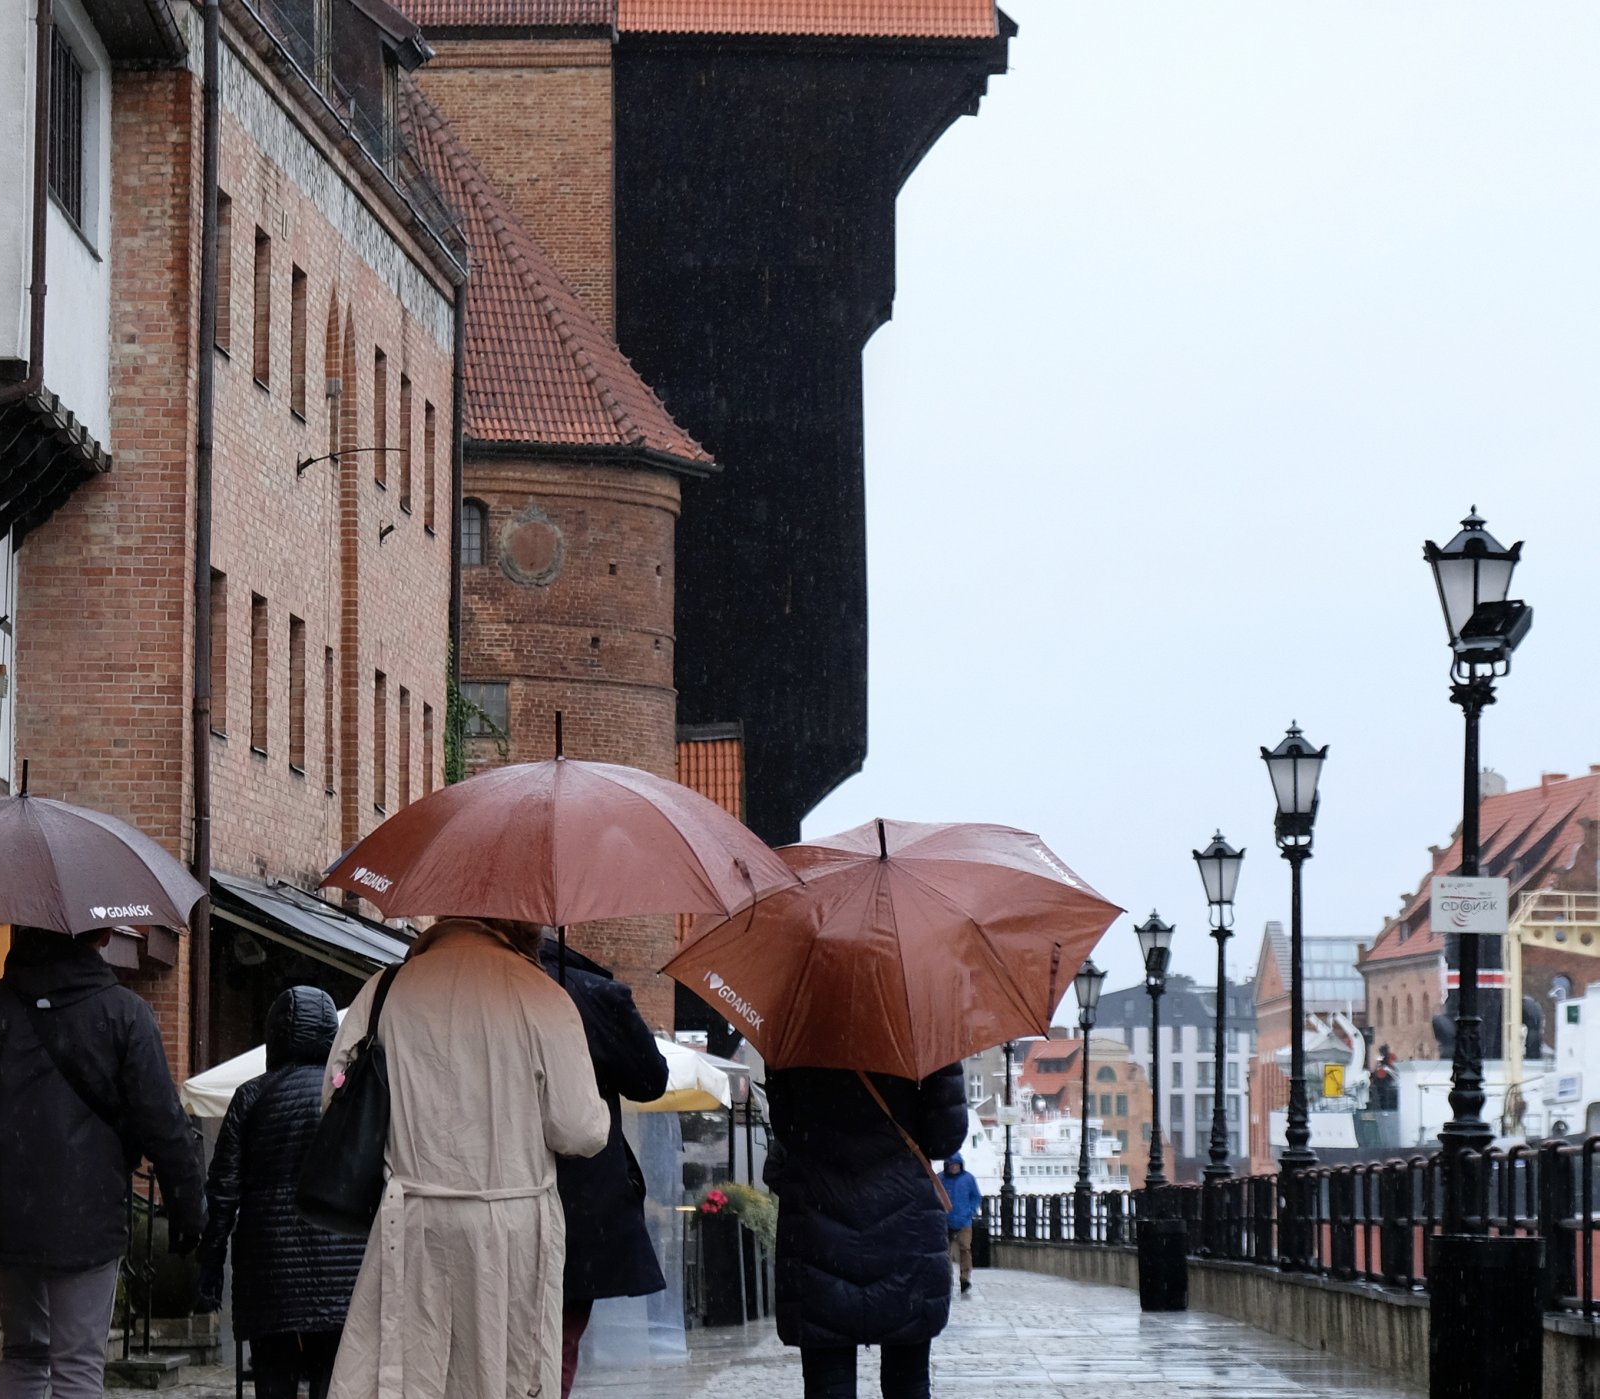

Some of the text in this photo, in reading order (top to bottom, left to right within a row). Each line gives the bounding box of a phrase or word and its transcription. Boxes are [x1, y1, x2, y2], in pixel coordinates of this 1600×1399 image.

[350, 866, 393, 894] I GDAŃSK
[90, 903, 153, 919] I GDAŃSK
[703, 970, 764, 1031] I GDAŃSK
